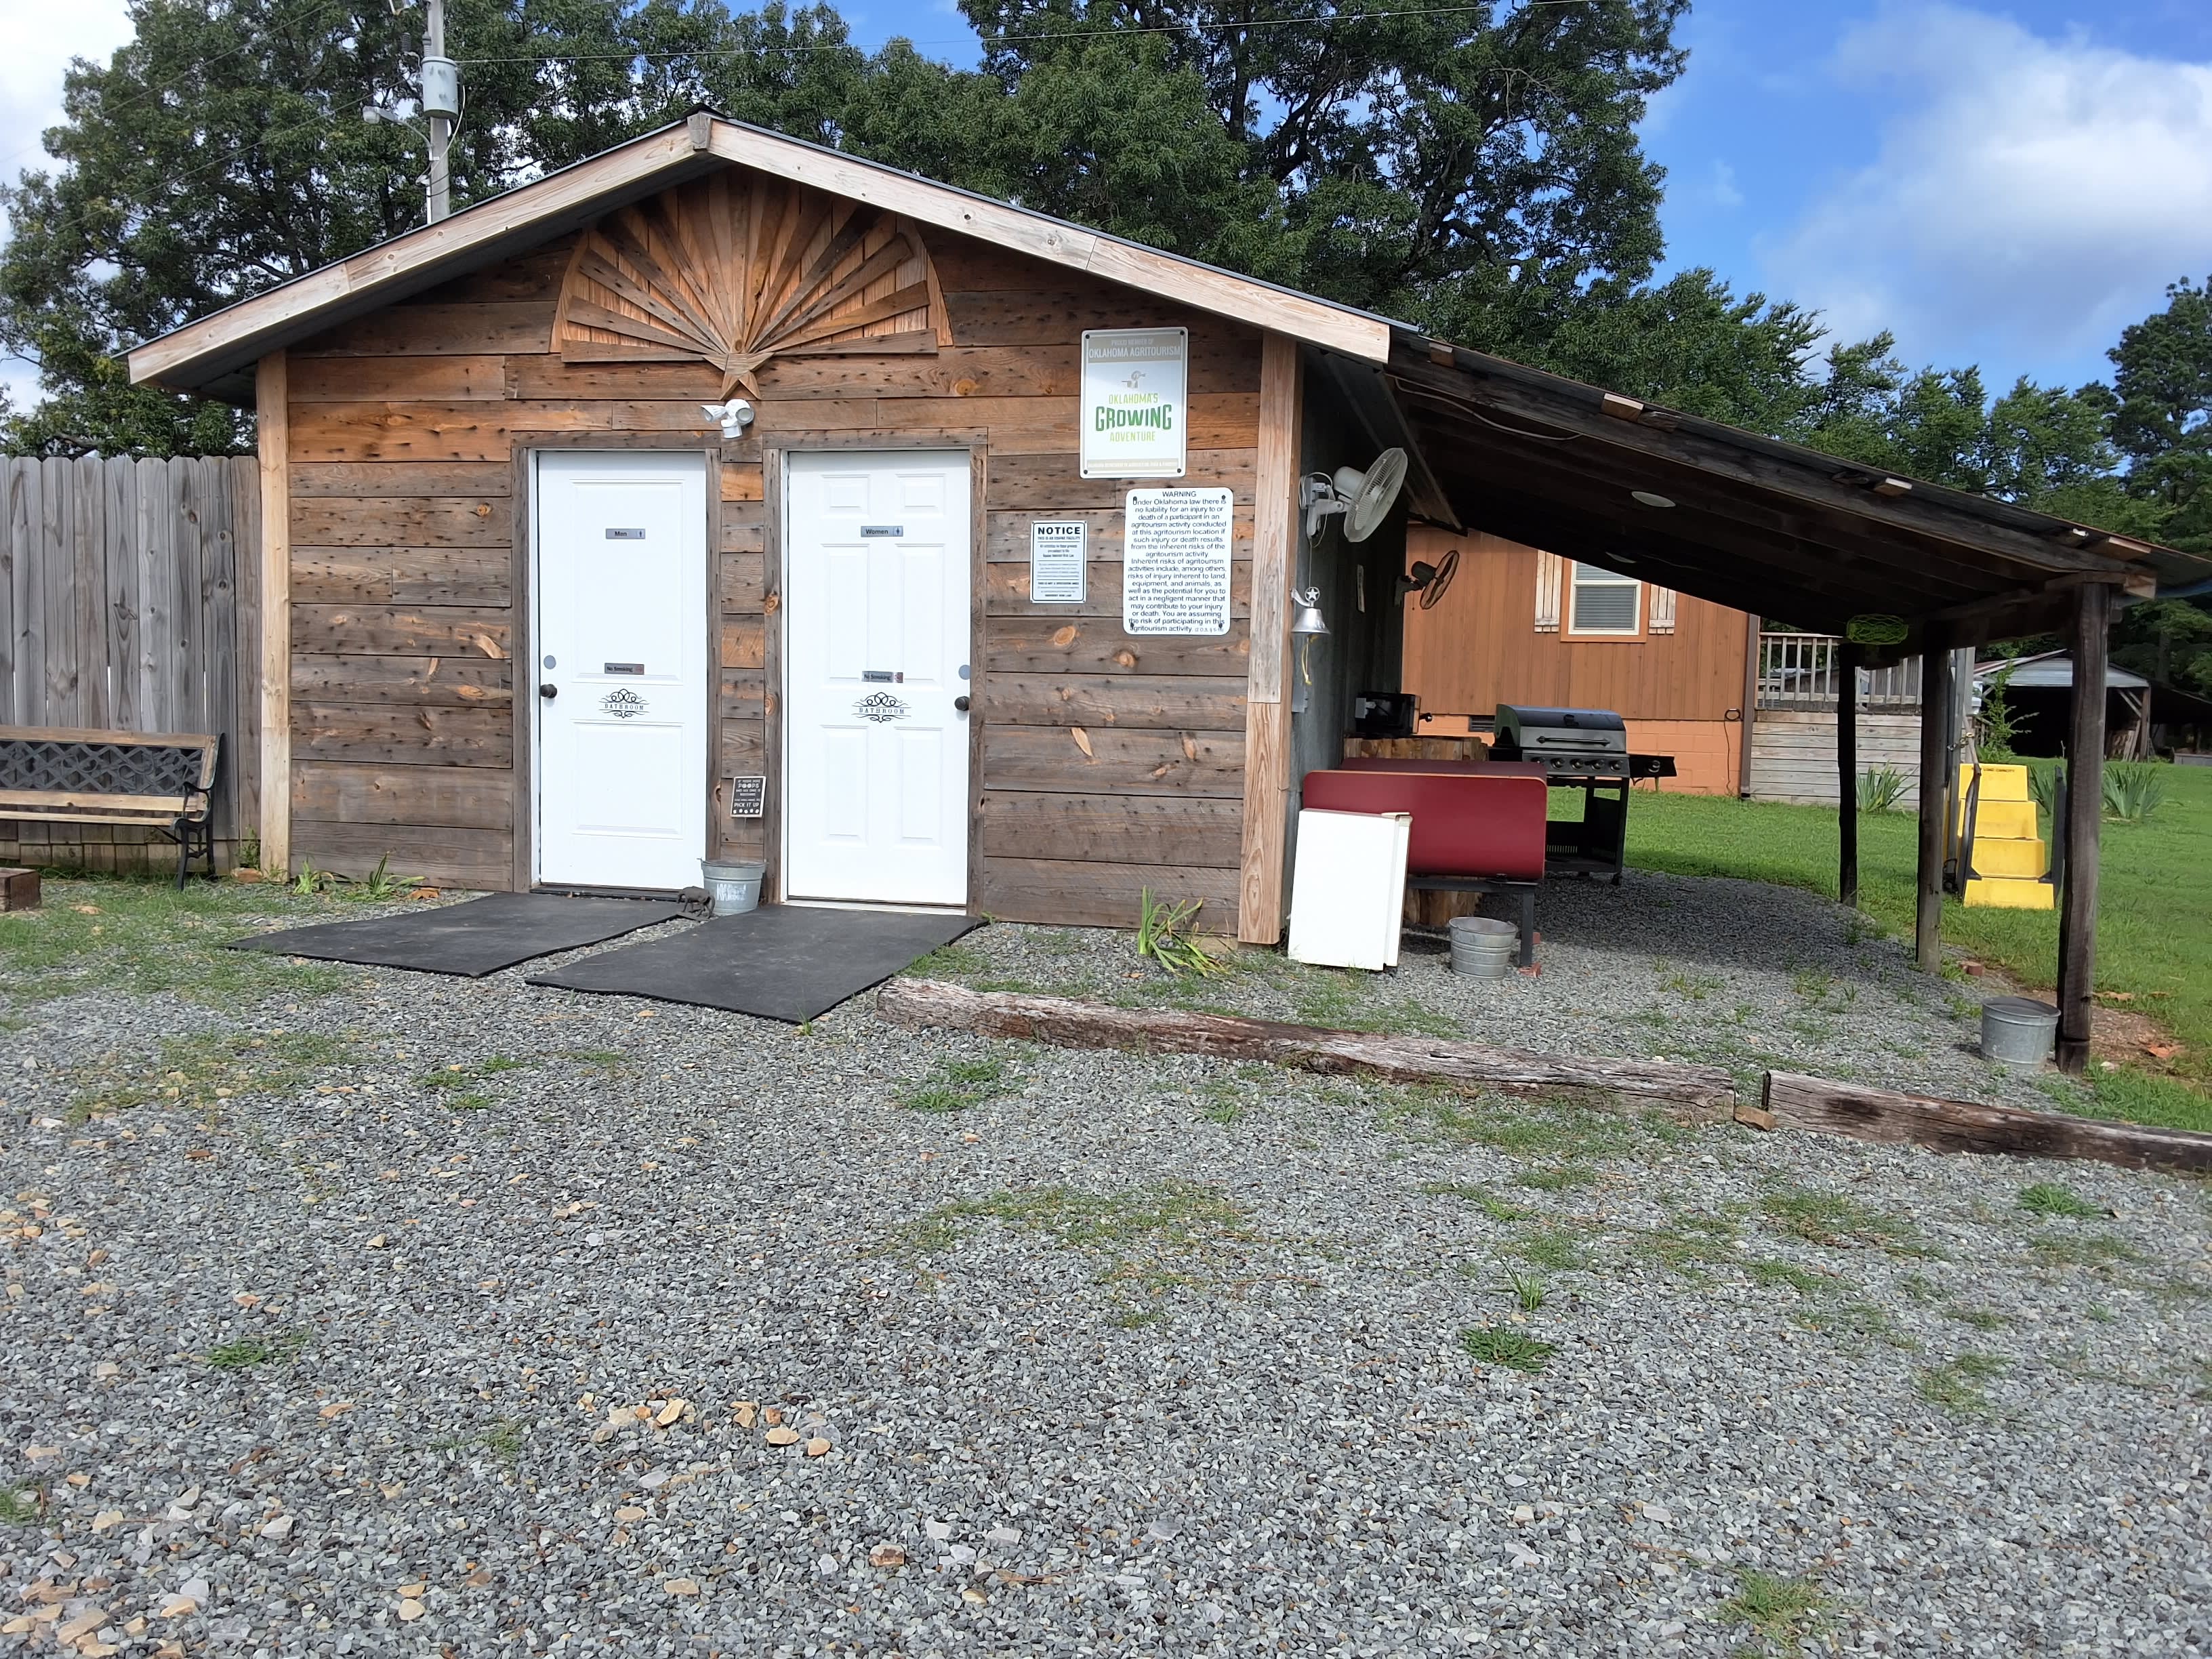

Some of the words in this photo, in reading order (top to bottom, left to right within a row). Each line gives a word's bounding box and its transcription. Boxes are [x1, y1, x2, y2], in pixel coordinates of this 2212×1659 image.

[1089, 348, 1128, 358] OKLAHOMA
[1130, 346, 1180, 356] AGRITOURISM
[1109, 393, 1158, 404] OKLAHOMA'S
[1096, 405, 1172, 431] GROWING
[1110, 431, 1155, 442] ADVENTURE
